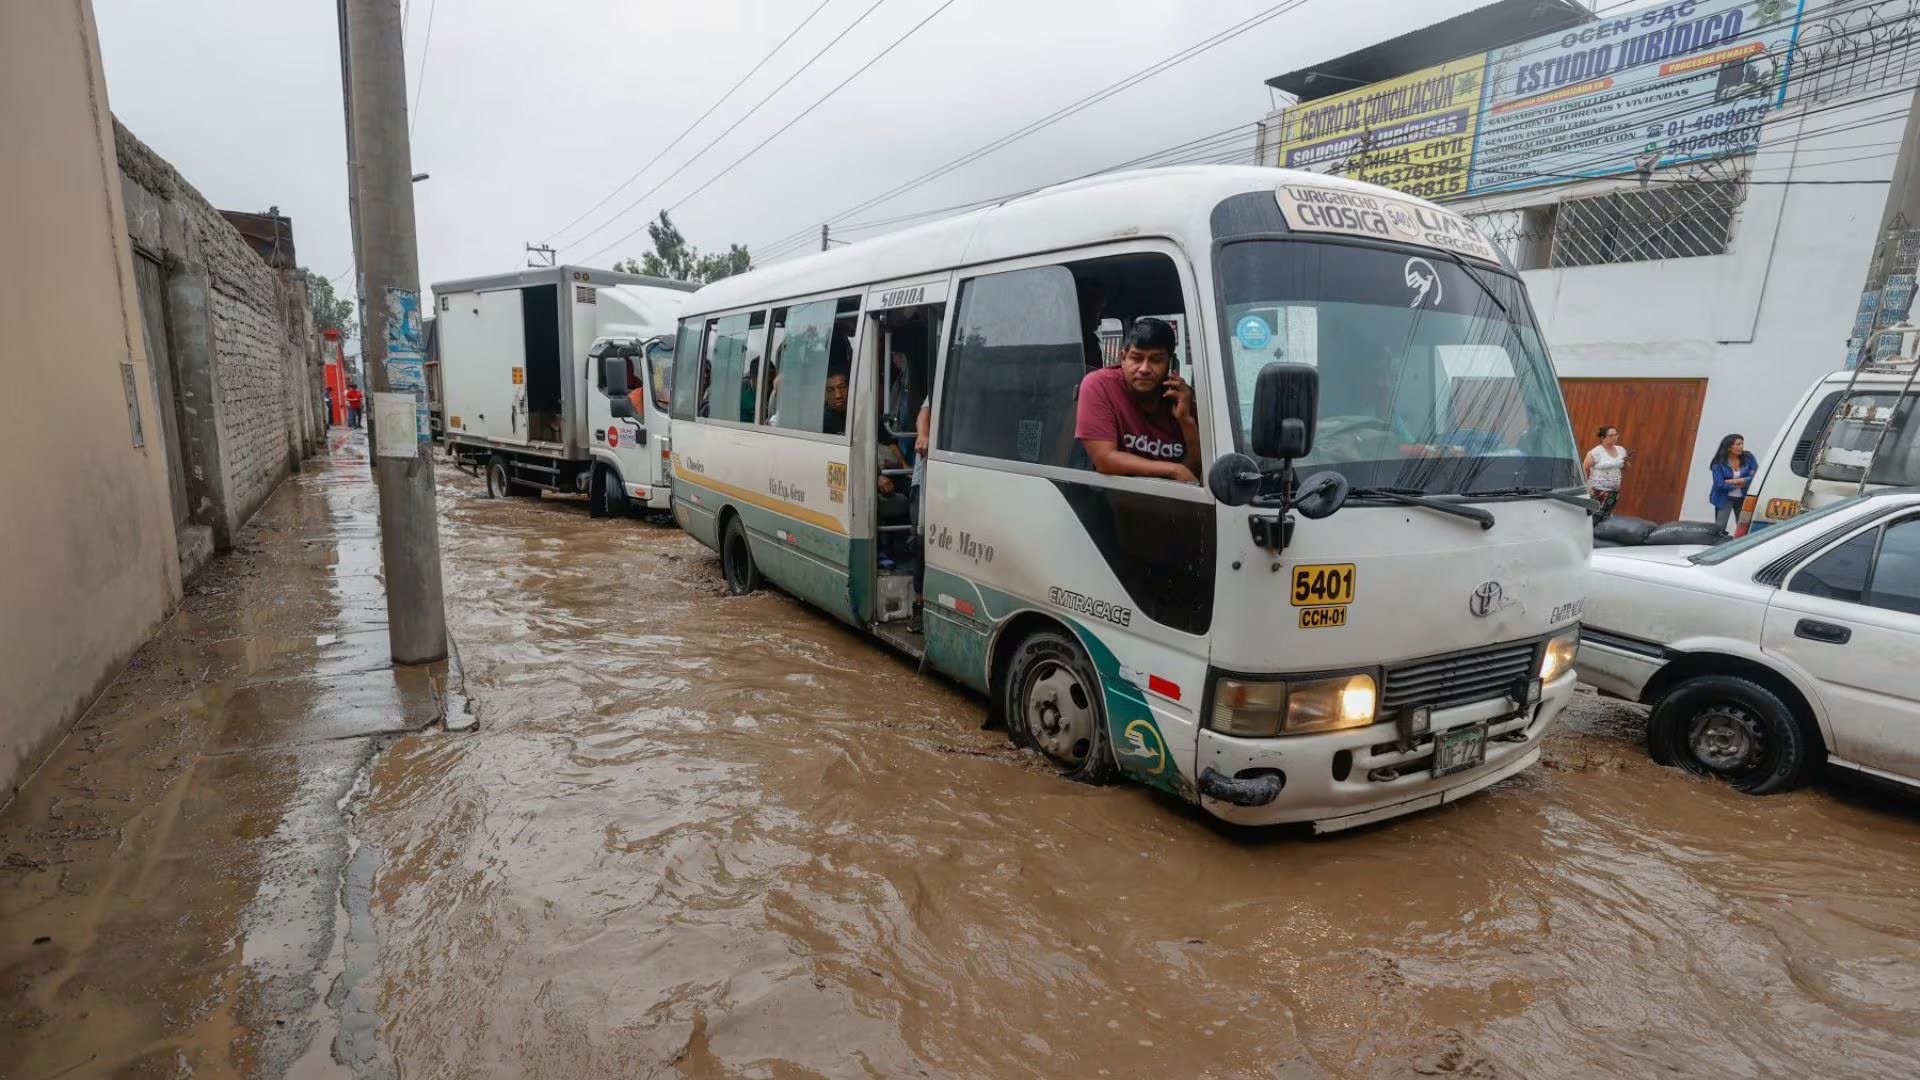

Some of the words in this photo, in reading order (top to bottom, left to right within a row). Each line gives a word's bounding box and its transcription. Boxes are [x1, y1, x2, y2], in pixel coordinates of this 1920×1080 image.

[1516, 44, 1612, 95] ESTUDIO
[1615, 8, 1744, 71] JURÍDICO
[1668, 53, 1714, 73] PROCESOS
[1716, 45, 1756, 62] PENALES
[1300, 103, 1344, 142] CENTRO
[1345, 97, 1362, 131] DE
[1363, 81, 1455, 125] CONCILIACIÓN
[1488, 106, 1557, 126] SANEAMIENTO
[1560, 104, 1613, 121] TERRENOS
[1616, 101, 1625, 111] Y
[1626, 88, 1689, 108] VIVIENDAS
[1293, 135, 1374, 165] SOLUCIONS
[1376, 116, 1458, 148] JURÍDICAS
[1423, 136, 1466, 160] CIVIL
[881, 286, 925, 308] SUBIDA
[1123, 433, 1184, 458] adidas
[686, 456, 705, 474] Chosica
[827, 464, 847, 488] 5401
[929, 523, 937, 546] 2
[938, 527, 953, 551] de
[959, 531, 994, 565] Mayo
[1295, 568, 1353, 601] 5401
[1048, 586, 1131, 626] EMTRACACE
